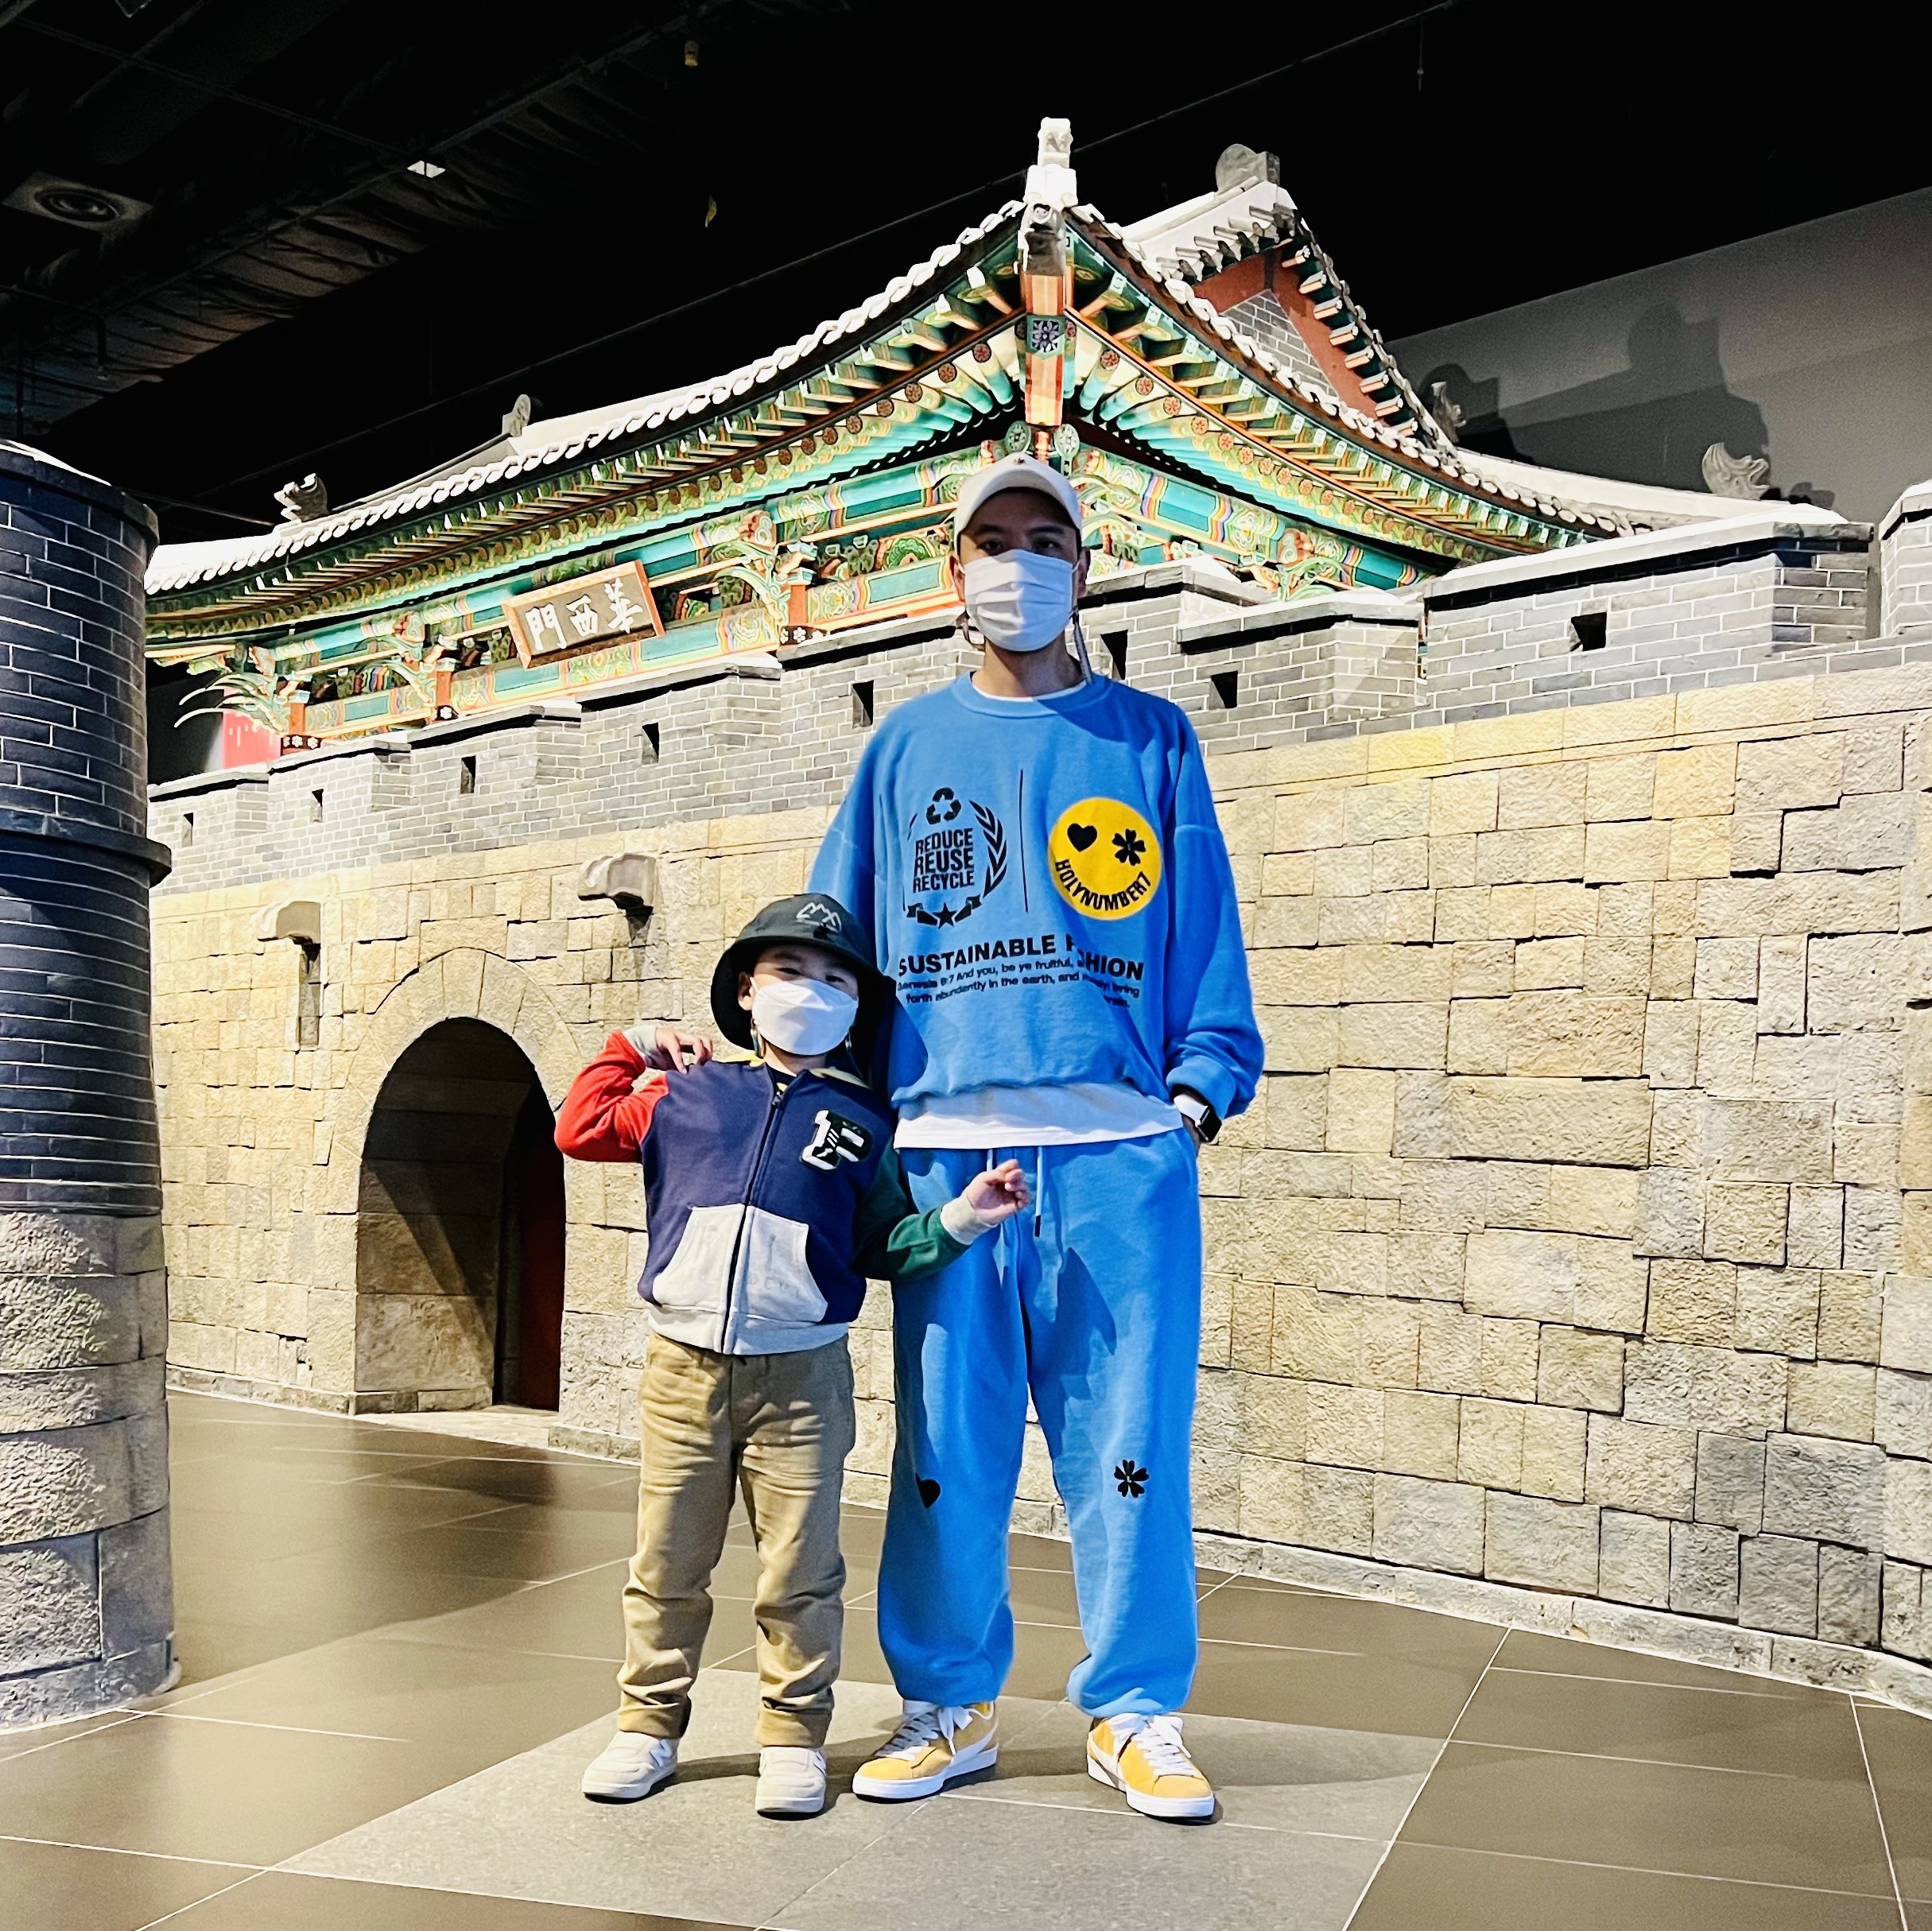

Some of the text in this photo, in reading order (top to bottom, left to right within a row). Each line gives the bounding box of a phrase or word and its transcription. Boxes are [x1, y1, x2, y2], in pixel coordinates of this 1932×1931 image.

[915, 828, 973, 857] REDUCE
[914, 847, 974, 877] REUSE
[913, 870, 975, 893] RECYCLE
[1055, 859, 1150, 911] HOLYNUMBER7
[898, 934, 1057, 976] SUSTAINABLE
